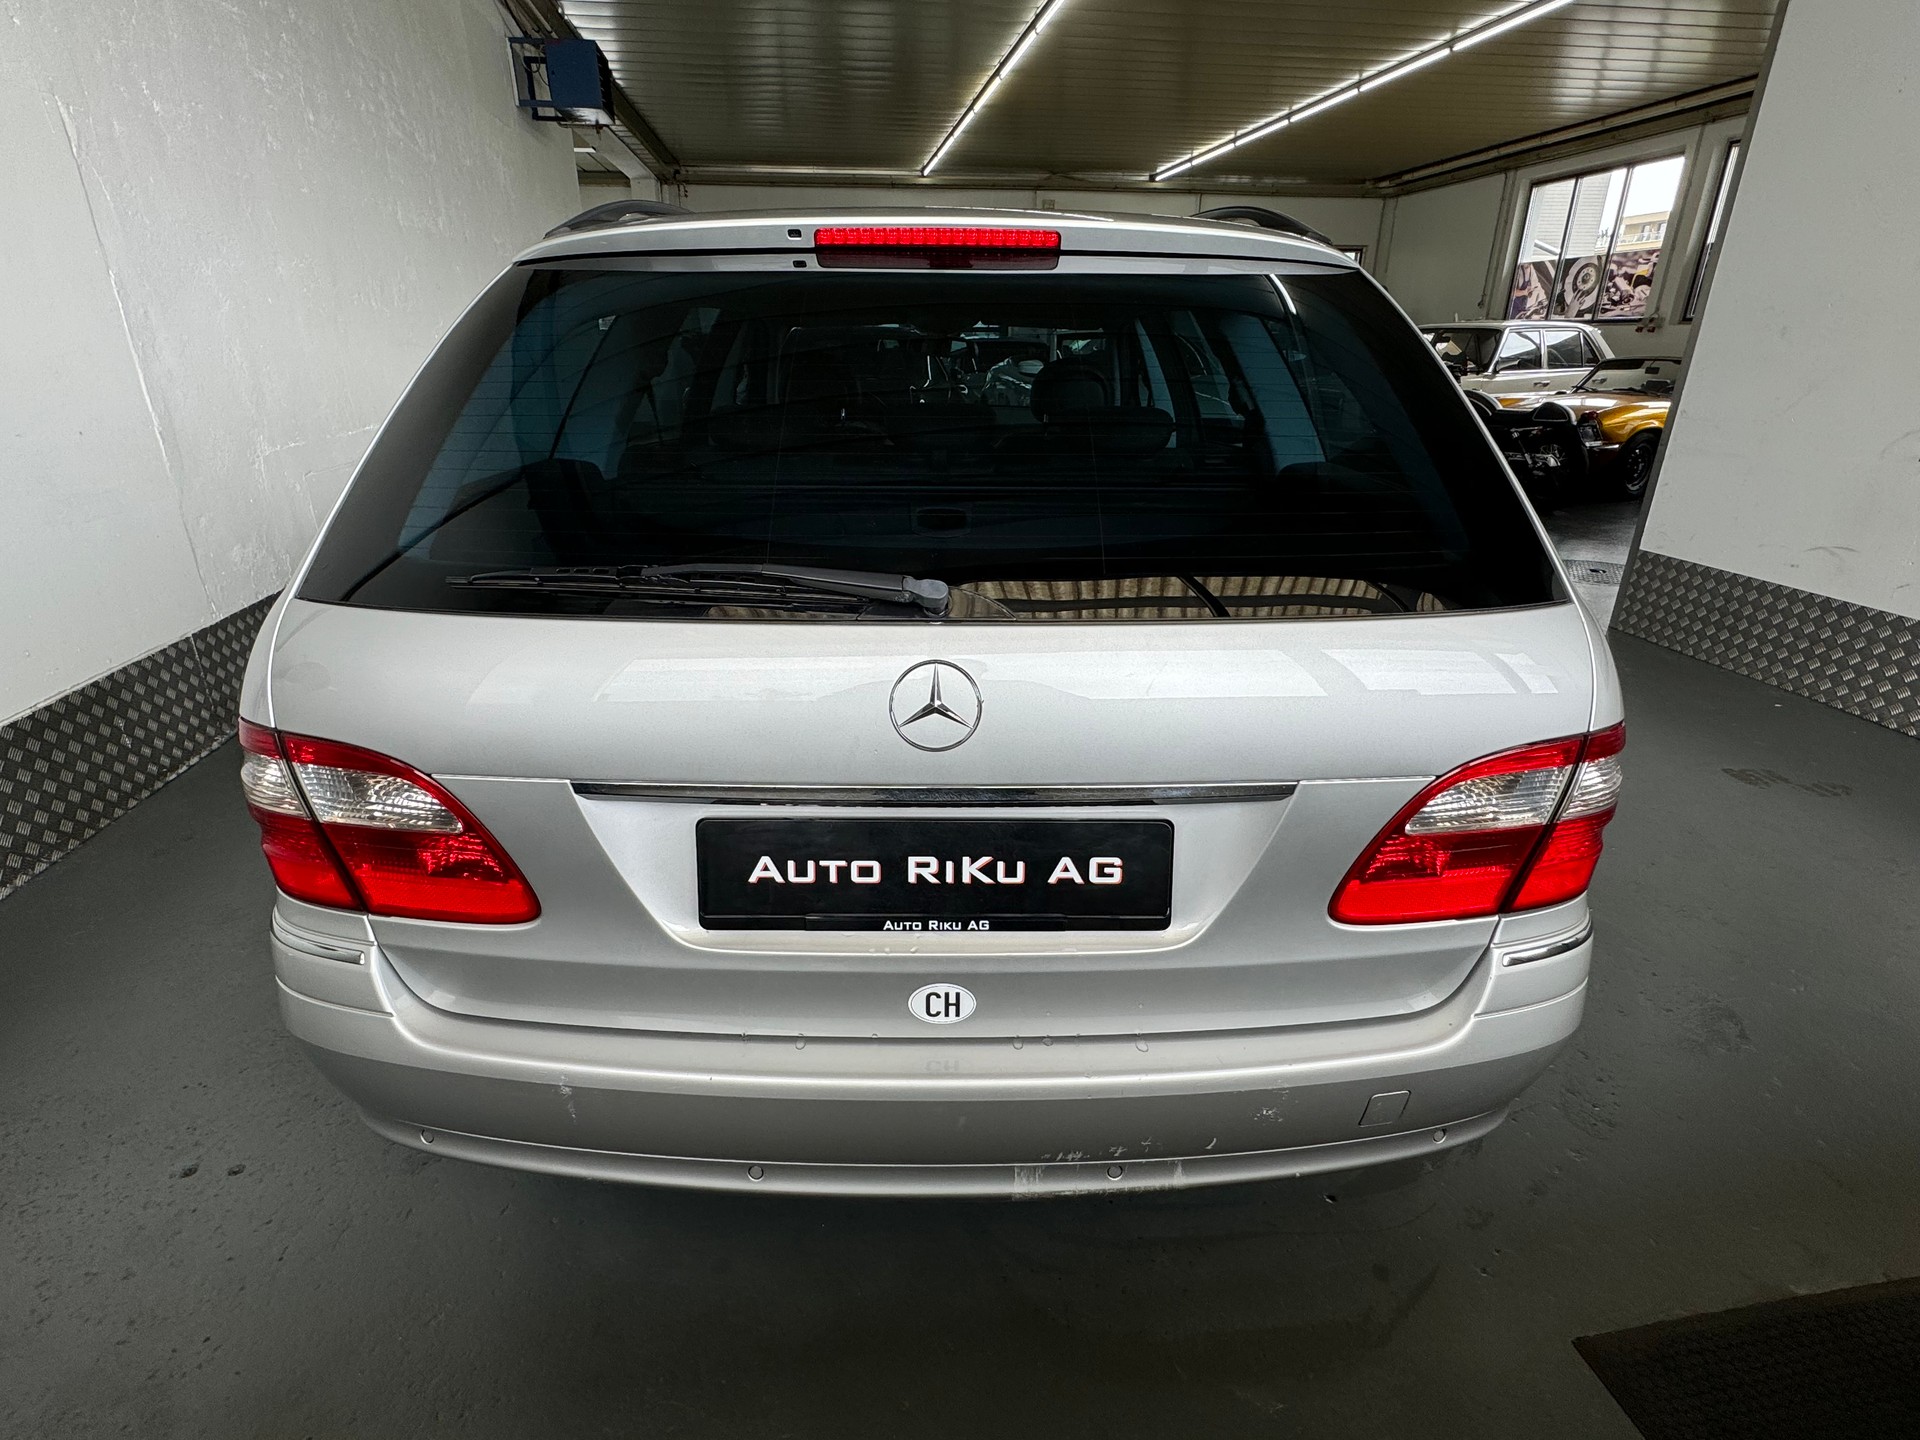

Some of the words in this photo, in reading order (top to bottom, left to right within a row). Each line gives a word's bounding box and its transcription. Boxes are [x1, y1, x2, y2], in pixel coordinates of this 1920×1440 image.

[748, 856, 881, 884] AUTO
[1047, 856, 1123, 884] AG
[883, 920, 922, 931] AUTO
[928, 920, 962, 931] RIKU
[967, 920, 990, 931] AG
[925, 991, 961, 1018] CH
